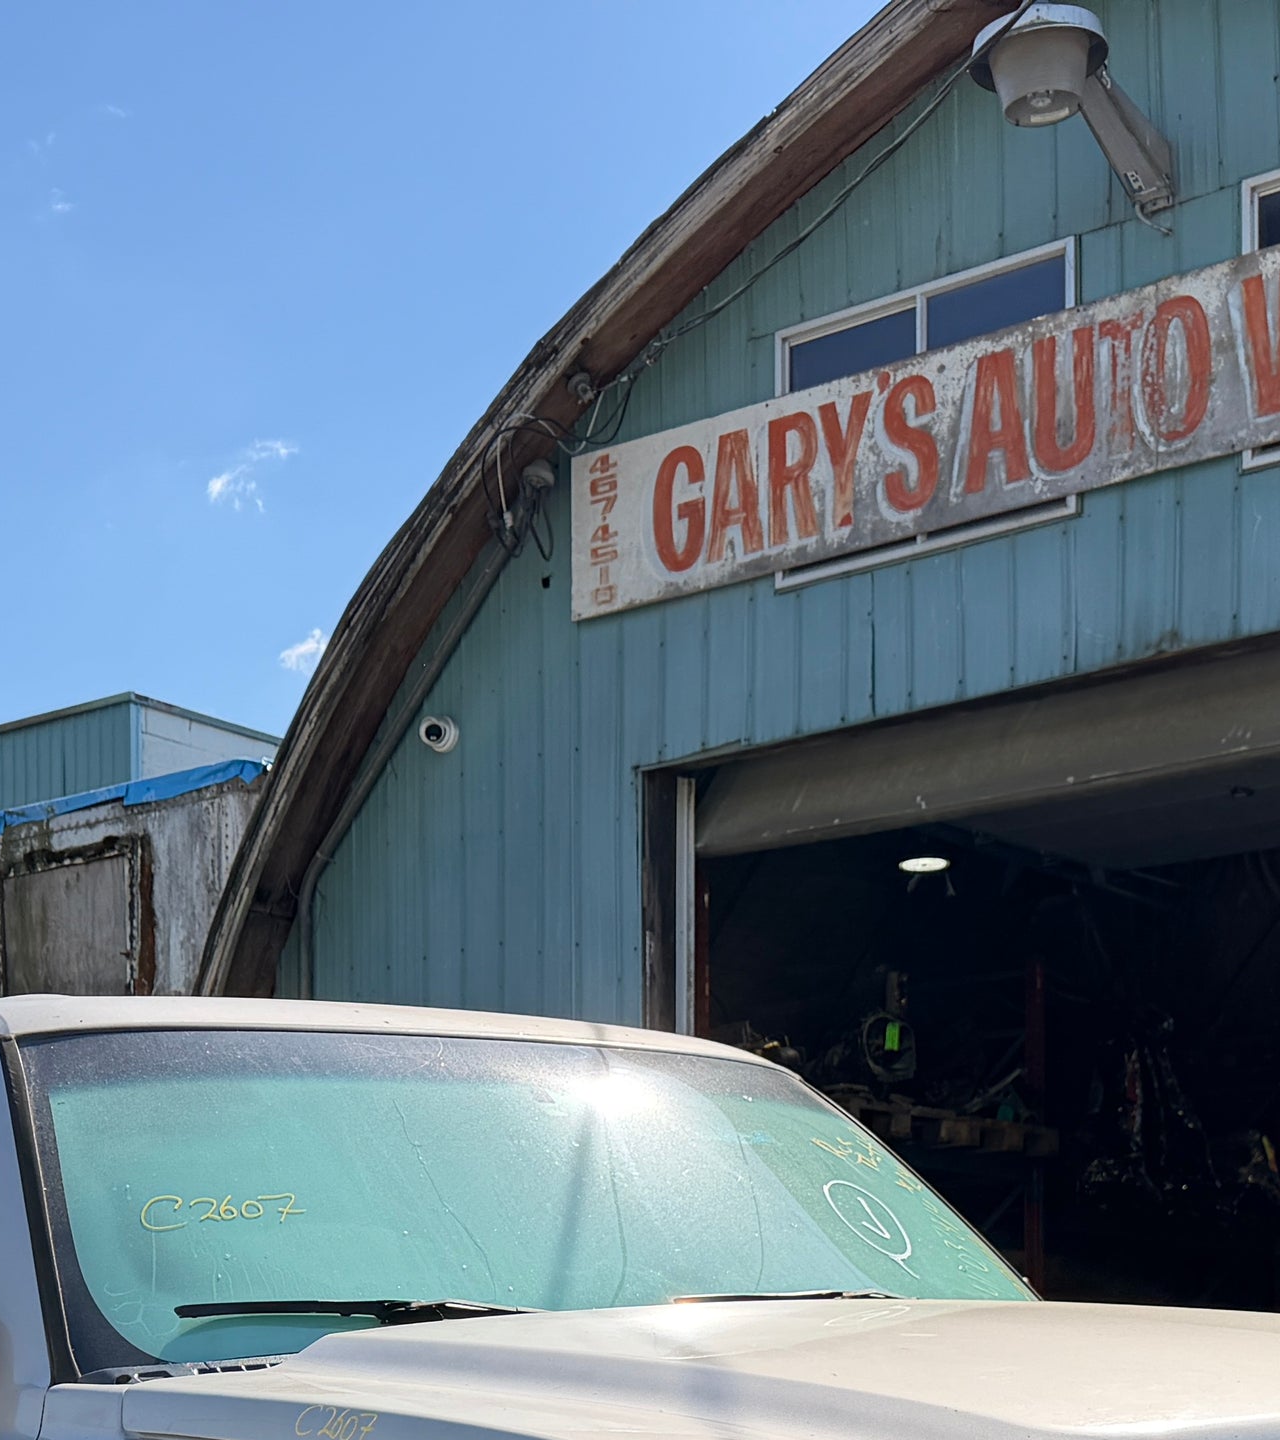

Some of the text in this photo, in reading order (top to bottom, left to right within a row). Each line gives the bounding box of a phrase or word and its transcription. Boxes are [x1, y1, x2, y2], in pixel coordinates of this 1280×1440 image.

[652, 370, 940, 573] GARY'S
[963, 295, 1211, 495] AUTO
[140, 1192, 307, 1232] C2607
